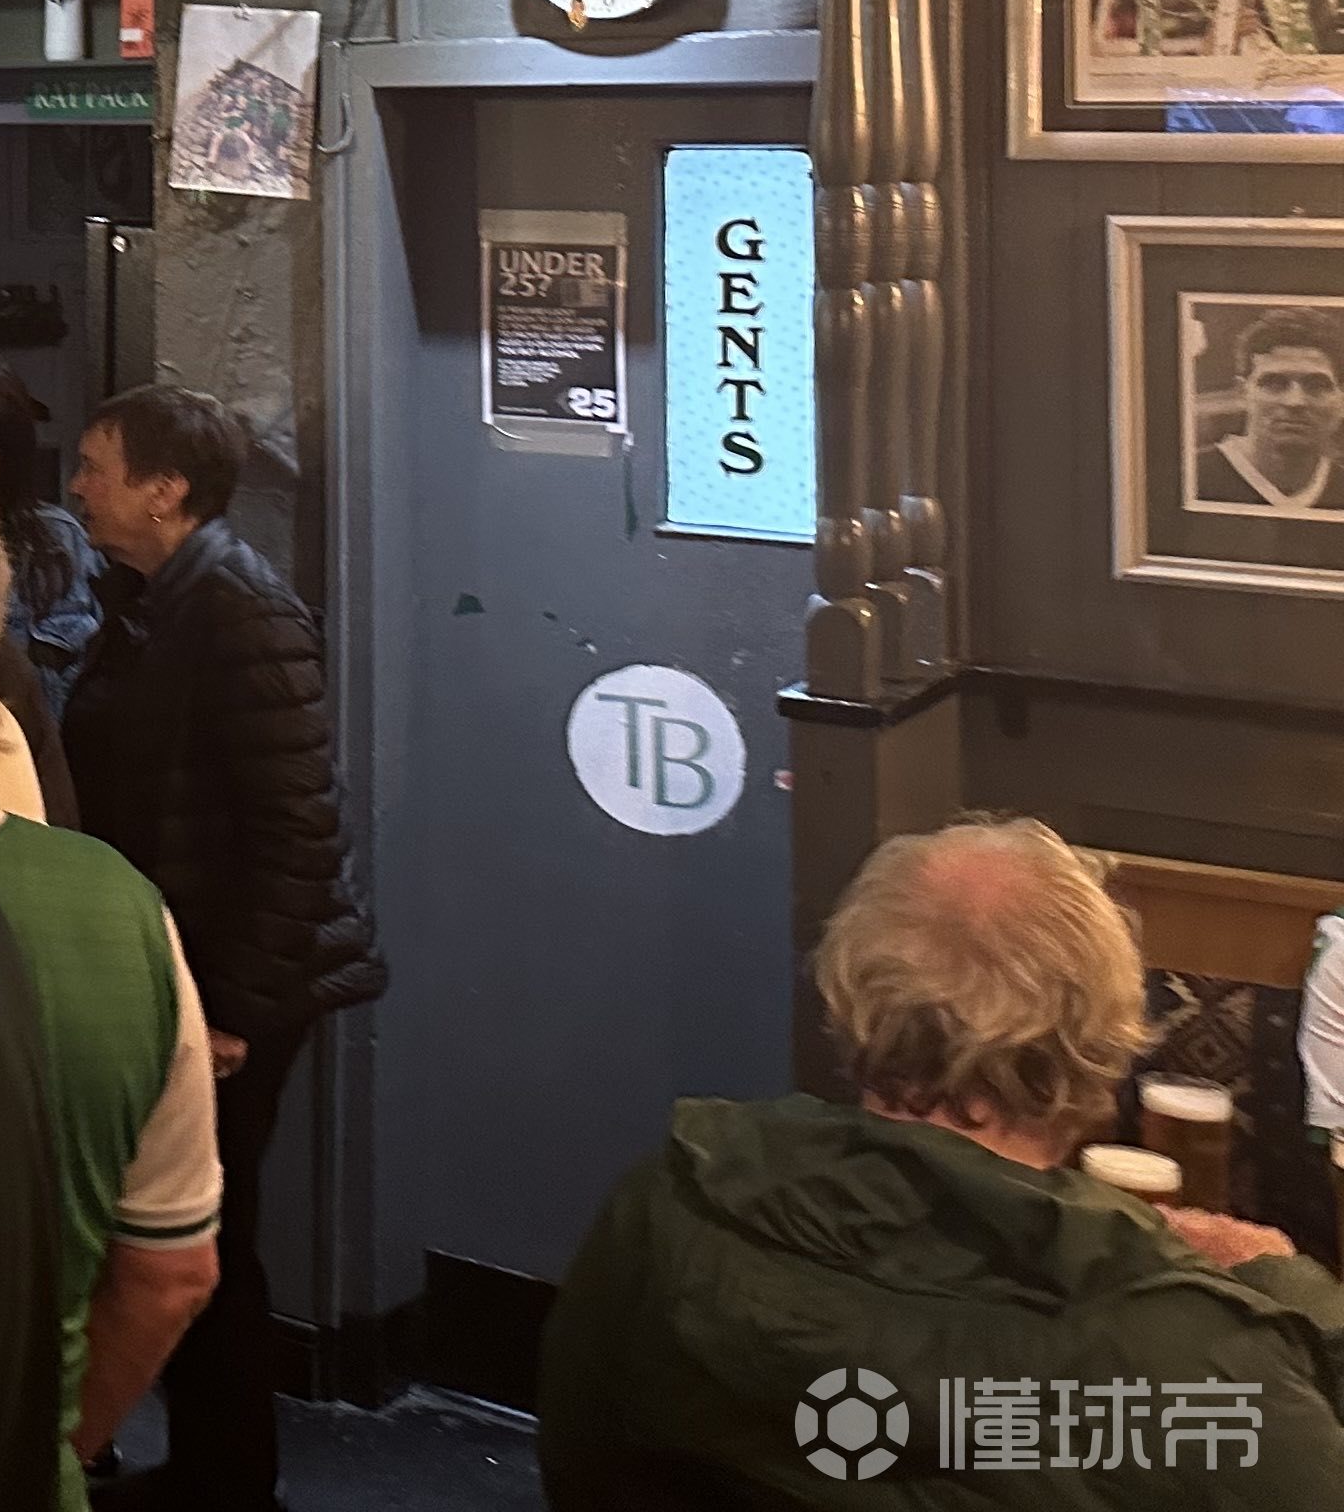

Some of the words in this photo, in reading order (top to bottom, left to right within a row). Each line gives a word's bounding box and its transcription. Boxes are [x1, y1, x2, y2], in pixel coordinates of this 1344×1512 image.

[497, 249, 607, 279] UNDER
[498, 273, 553, 298] 25?
[715, 218, 766, 477] GENTS
[568, 386, 617, 419] 25
